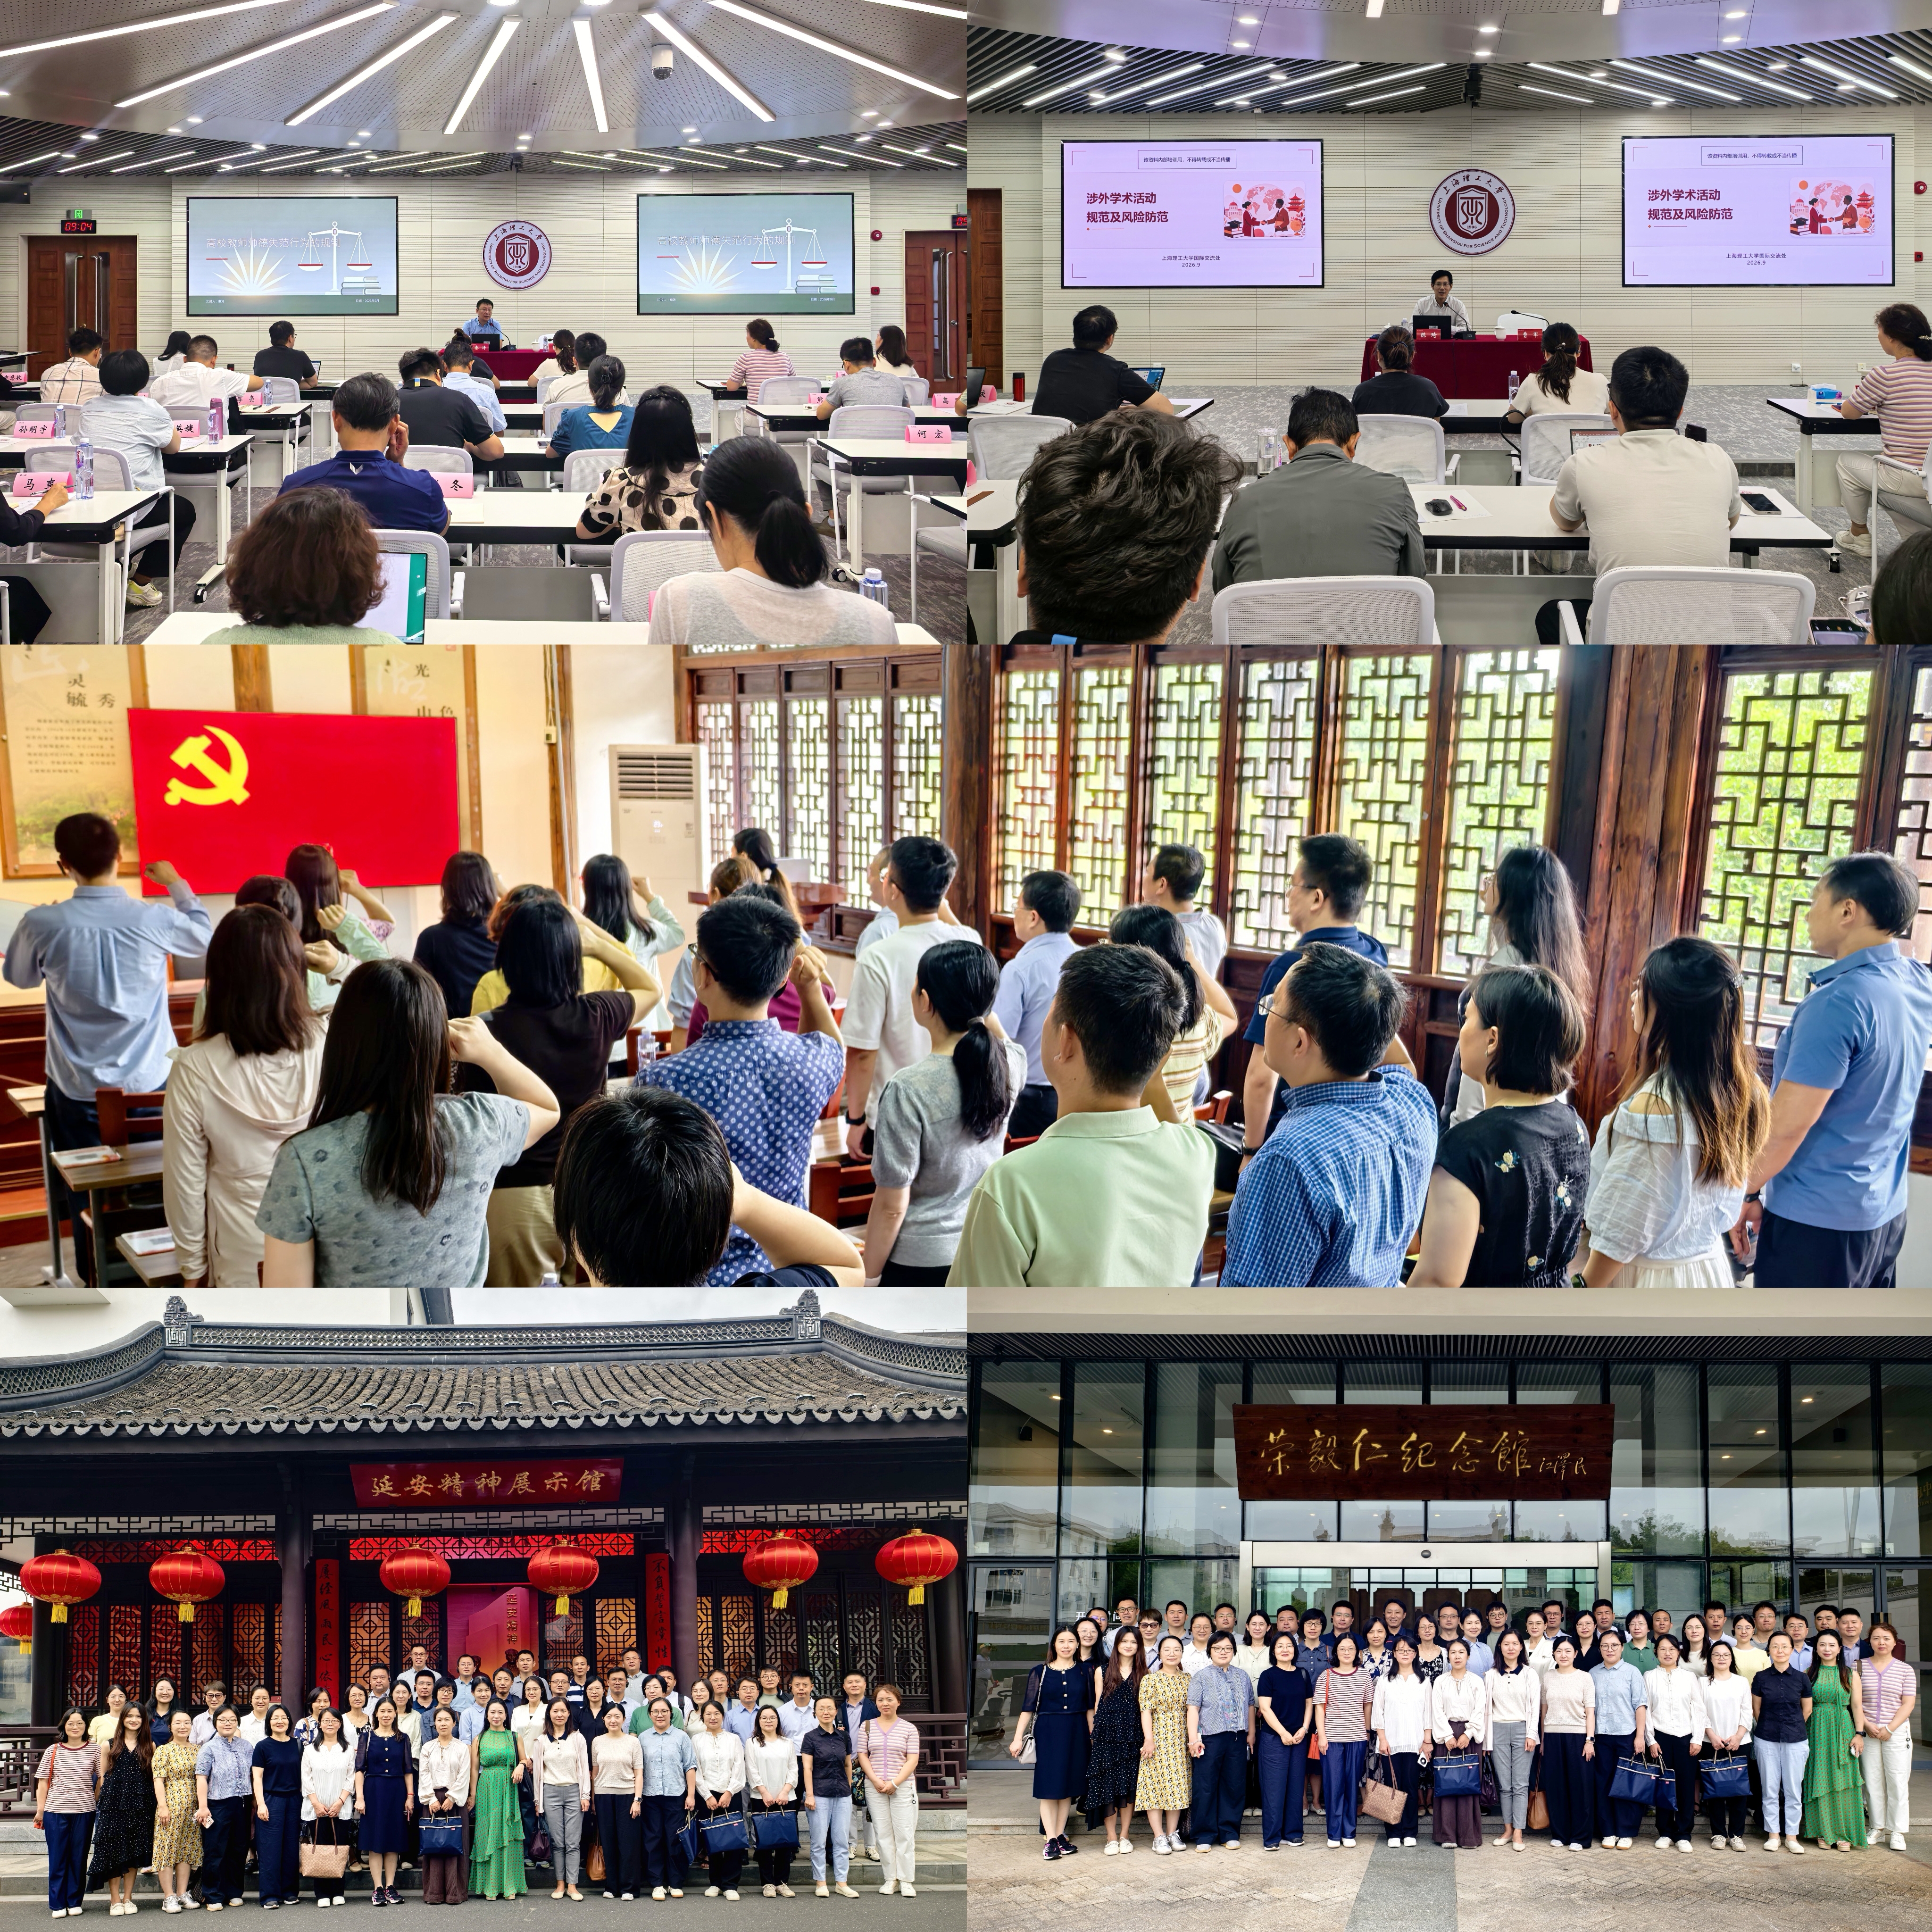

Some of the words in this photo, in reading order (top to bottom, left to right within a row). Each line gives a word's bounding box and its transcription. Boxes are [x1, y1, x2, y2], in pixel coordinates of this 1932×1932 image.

[1086, 192, 1156, 204] 涉外学术活动
[1648, 189, 1720, 201] 涉外学术活动
[1086, 211, 1168, 223] 规范及风险防范
[1648, 208, 1733, 220] 规范及风险防范
[65, 223, 92, 231] 09:04
[1443, 230, 1463, 247] SHANGHAI
[1474, 238, 1494, 248] SCIENCE
[1494, 230, 1502, 239] AND
[1500, 197, 1508, 229] TECHNOLOGY
[206, 238, 341, 248] 高校教师师德失范行为的规制
[657, 235, 795, 246] 高校教师师德失范行为的规制
[494, 269, 510, 283] SHANGHAI
[518, 275, 535, 283] SCIENCE
[917, 429, 943, 438] 何宏
[414, 664, 430, 678] 光
[68, 673, 85, 688] 灵
[371, 1469, 606, 1498] 延安精神展示馆
[506, 1594, 517, 1644] 延安精神
